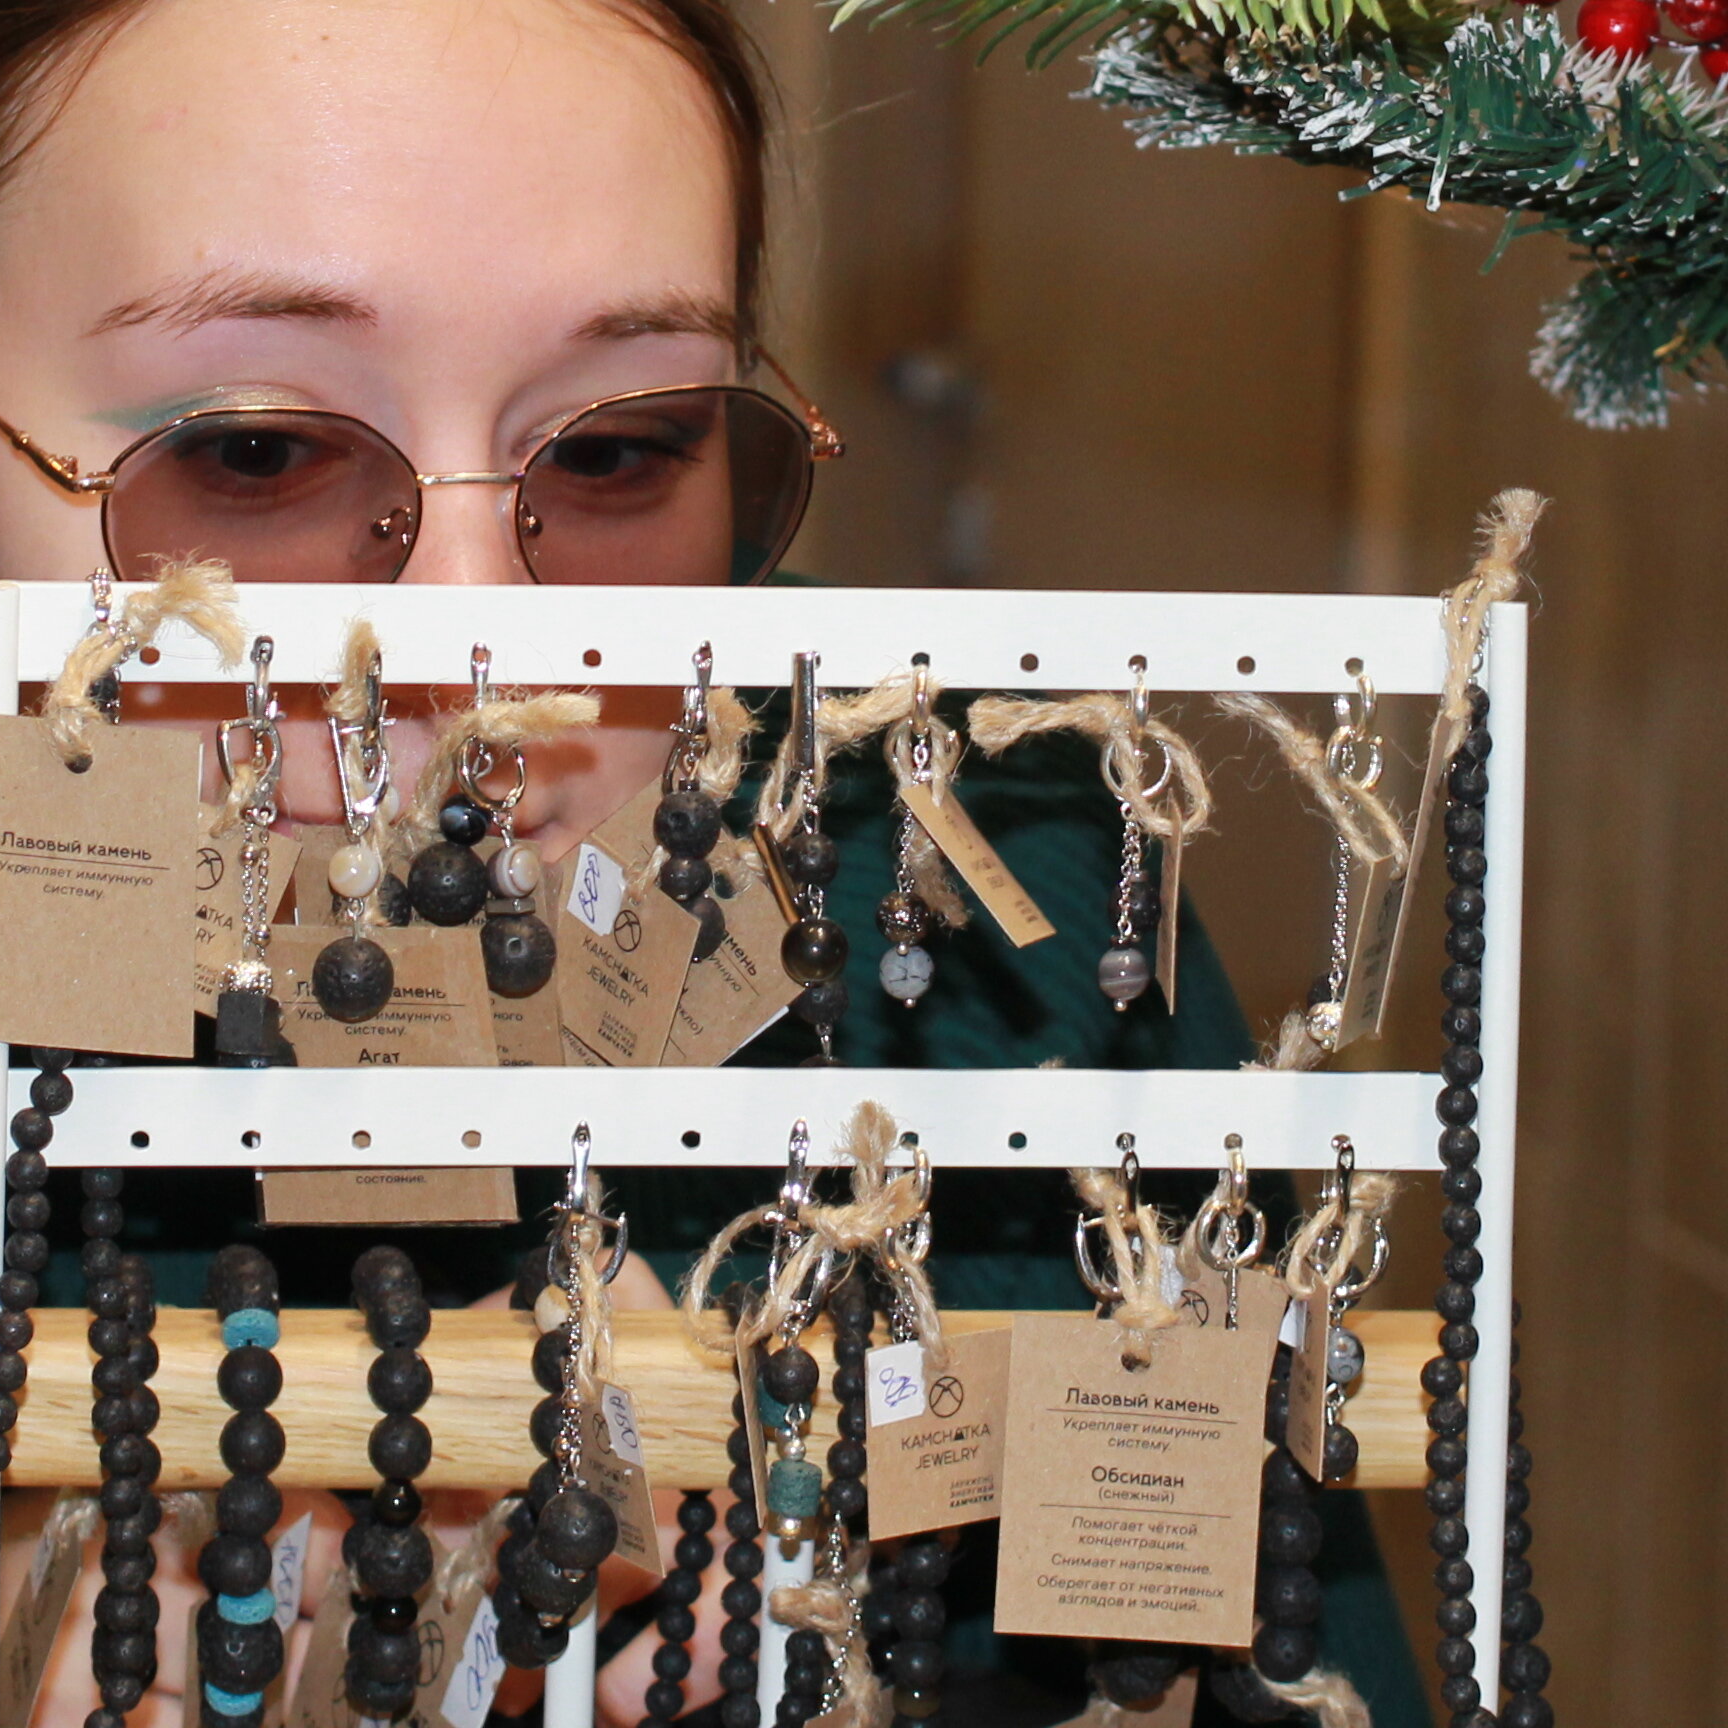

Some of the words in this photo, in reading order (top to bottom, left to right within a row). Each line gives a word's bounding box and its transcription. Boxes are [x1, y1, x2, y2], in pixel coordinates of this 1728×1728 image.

[1, 831, 81, 855] Лавовый
[87, 843, 152, 861] камень
[0, 860, 72, 879] Укрепляет
[76, 870, 153, 888] иммунную
[582, 935, 648, 998] KAMCHATKA
[391, 985, 446, 999] амень
[587, 964, 635, 1008] JEWELRY
[358, 1048, 401, 1064] Агат
[1065, 1388, 1148, 1408] Лавовый
[1154, 1398, 1220, 1415] камень
[901, 1423, 991, 1451] KAMCHATKA
[1063, 1418, 1137, 1433] Укрепляет
[1142, 1425, 1221, 1441] иммунную
[915, 1445, 980, 1470] JEWELRY
[1091, 1465, 1184, 1488] Обсидиан
[1098, 1487, 1175, 1504] (снежный)
[1071, 1516, 1143, 1532] Помогает
[1148, 1521, 1198, 1536] чёткой
[1078, 1536, 1188, 1552] концентрации.
[1051, 1553, 1115, 1569] Снимает
[1119, 1559, 1213, 1575] напряжение.
[1037, 1575, 1115, 1590] Оберегает
[1119, 1581, 1135, 1591] от
[1139, 1583, 1224, 1598] негативных
[1058, 1593, 1124, 1608] взглядов
[1127, 1597, 1136, 1607] и
[1140, 1598, 1201, 1612] эмоций.
